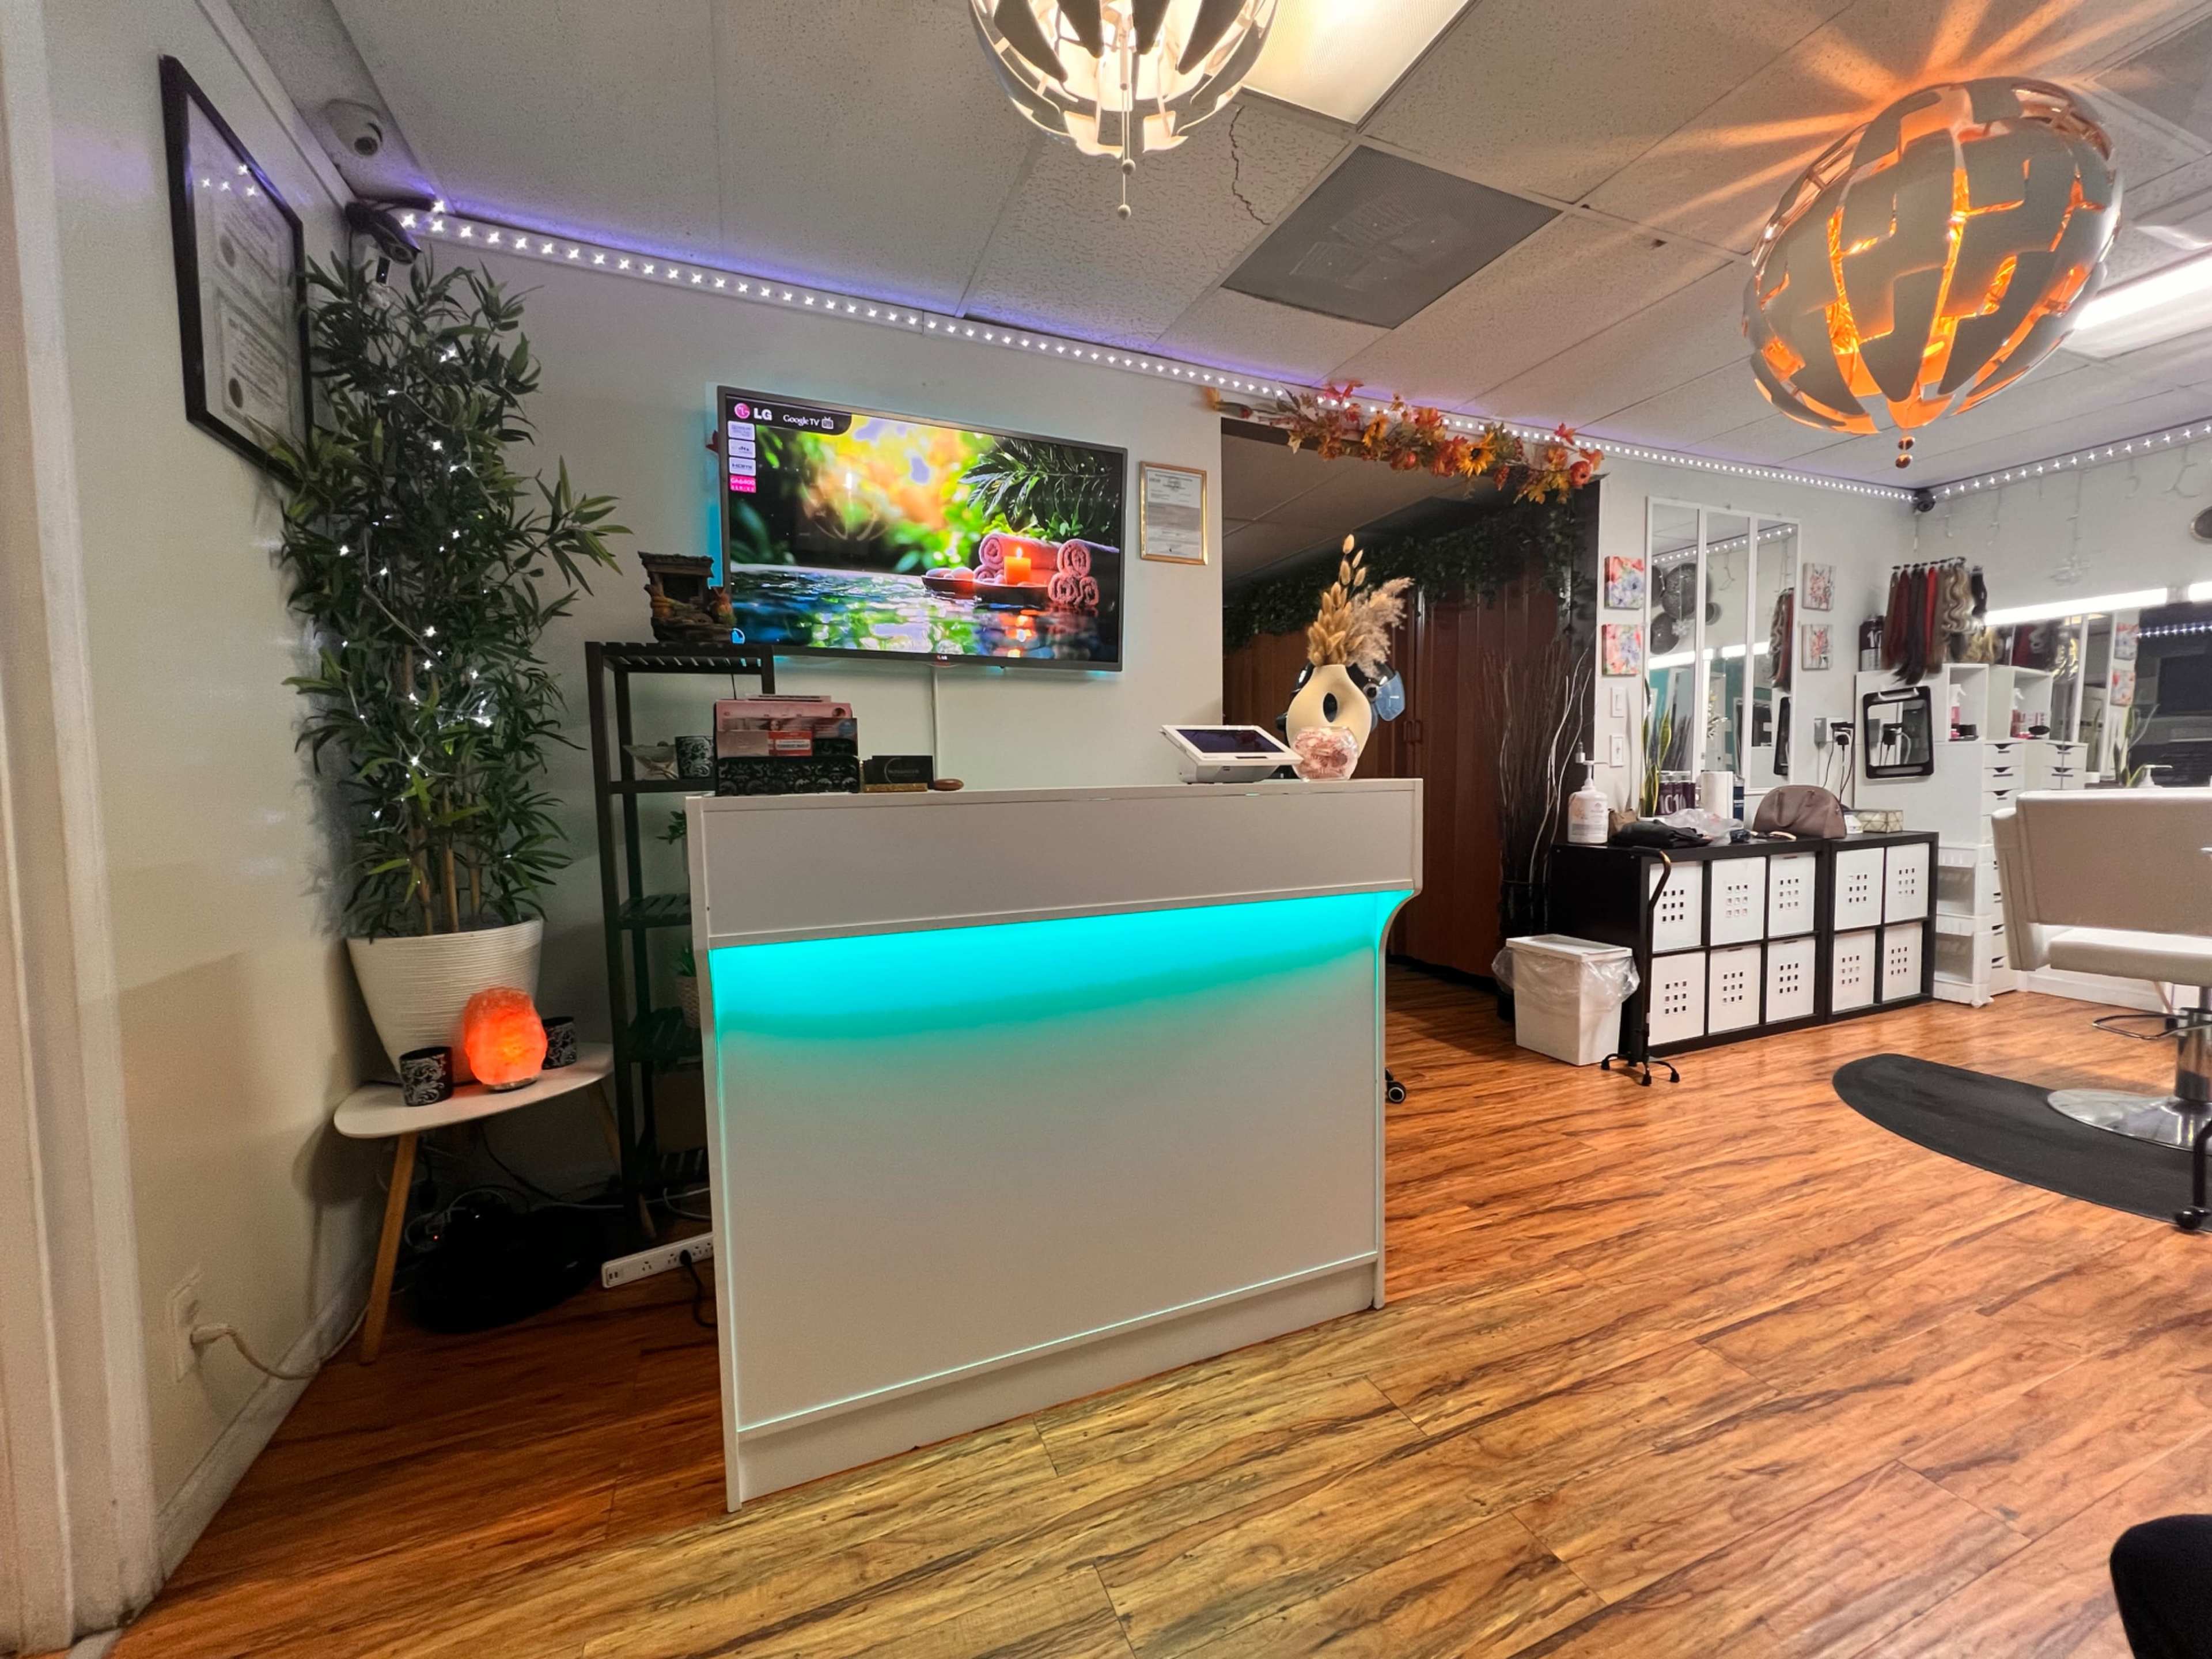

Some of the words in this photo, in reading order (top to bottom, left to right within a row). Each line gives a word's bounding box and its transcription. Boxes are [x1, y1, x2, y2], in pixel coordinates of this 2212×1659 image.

[753, 408, 772, 421] LG
[783, 414, 809, 427] Google
[809, 418, 820, 426] TV
